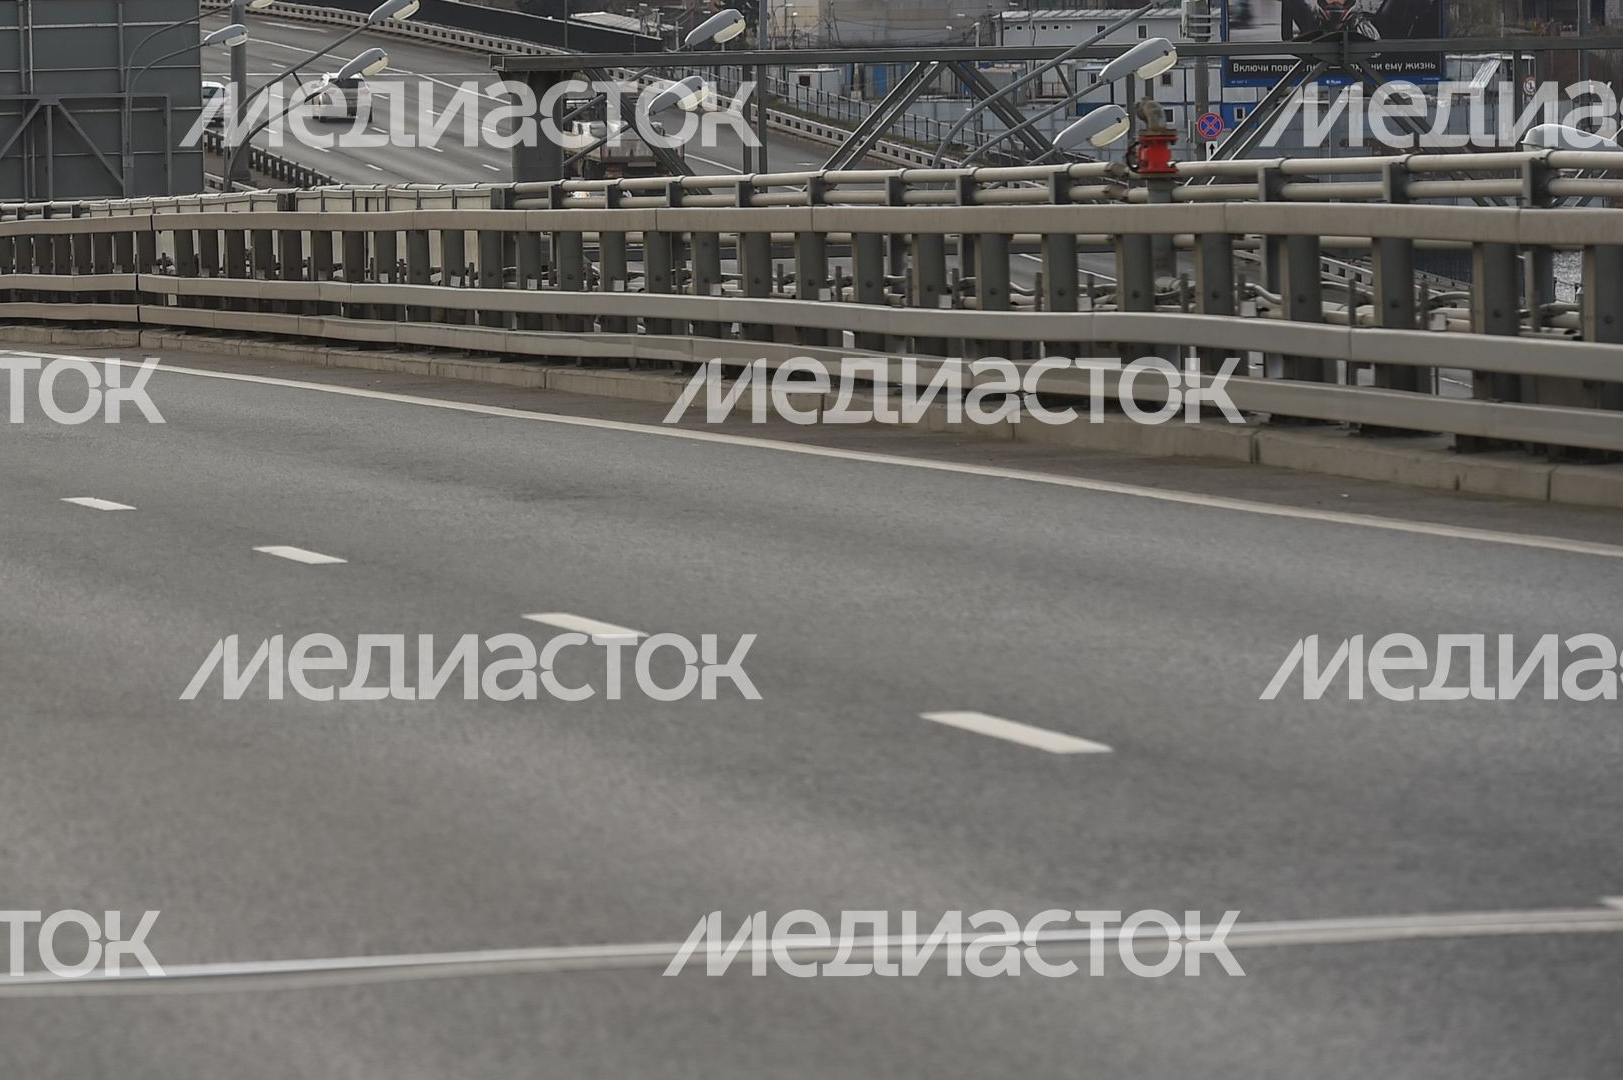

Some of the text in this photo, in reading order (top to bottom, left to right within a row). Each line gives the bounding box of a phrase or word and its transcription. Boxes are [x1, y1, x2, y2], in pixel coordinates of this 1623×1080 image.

[1233, 63, 1269, 72] Включи
[1384, 63, 1403, 73] ему
[1405, 62, 1436, 70] жизнь
